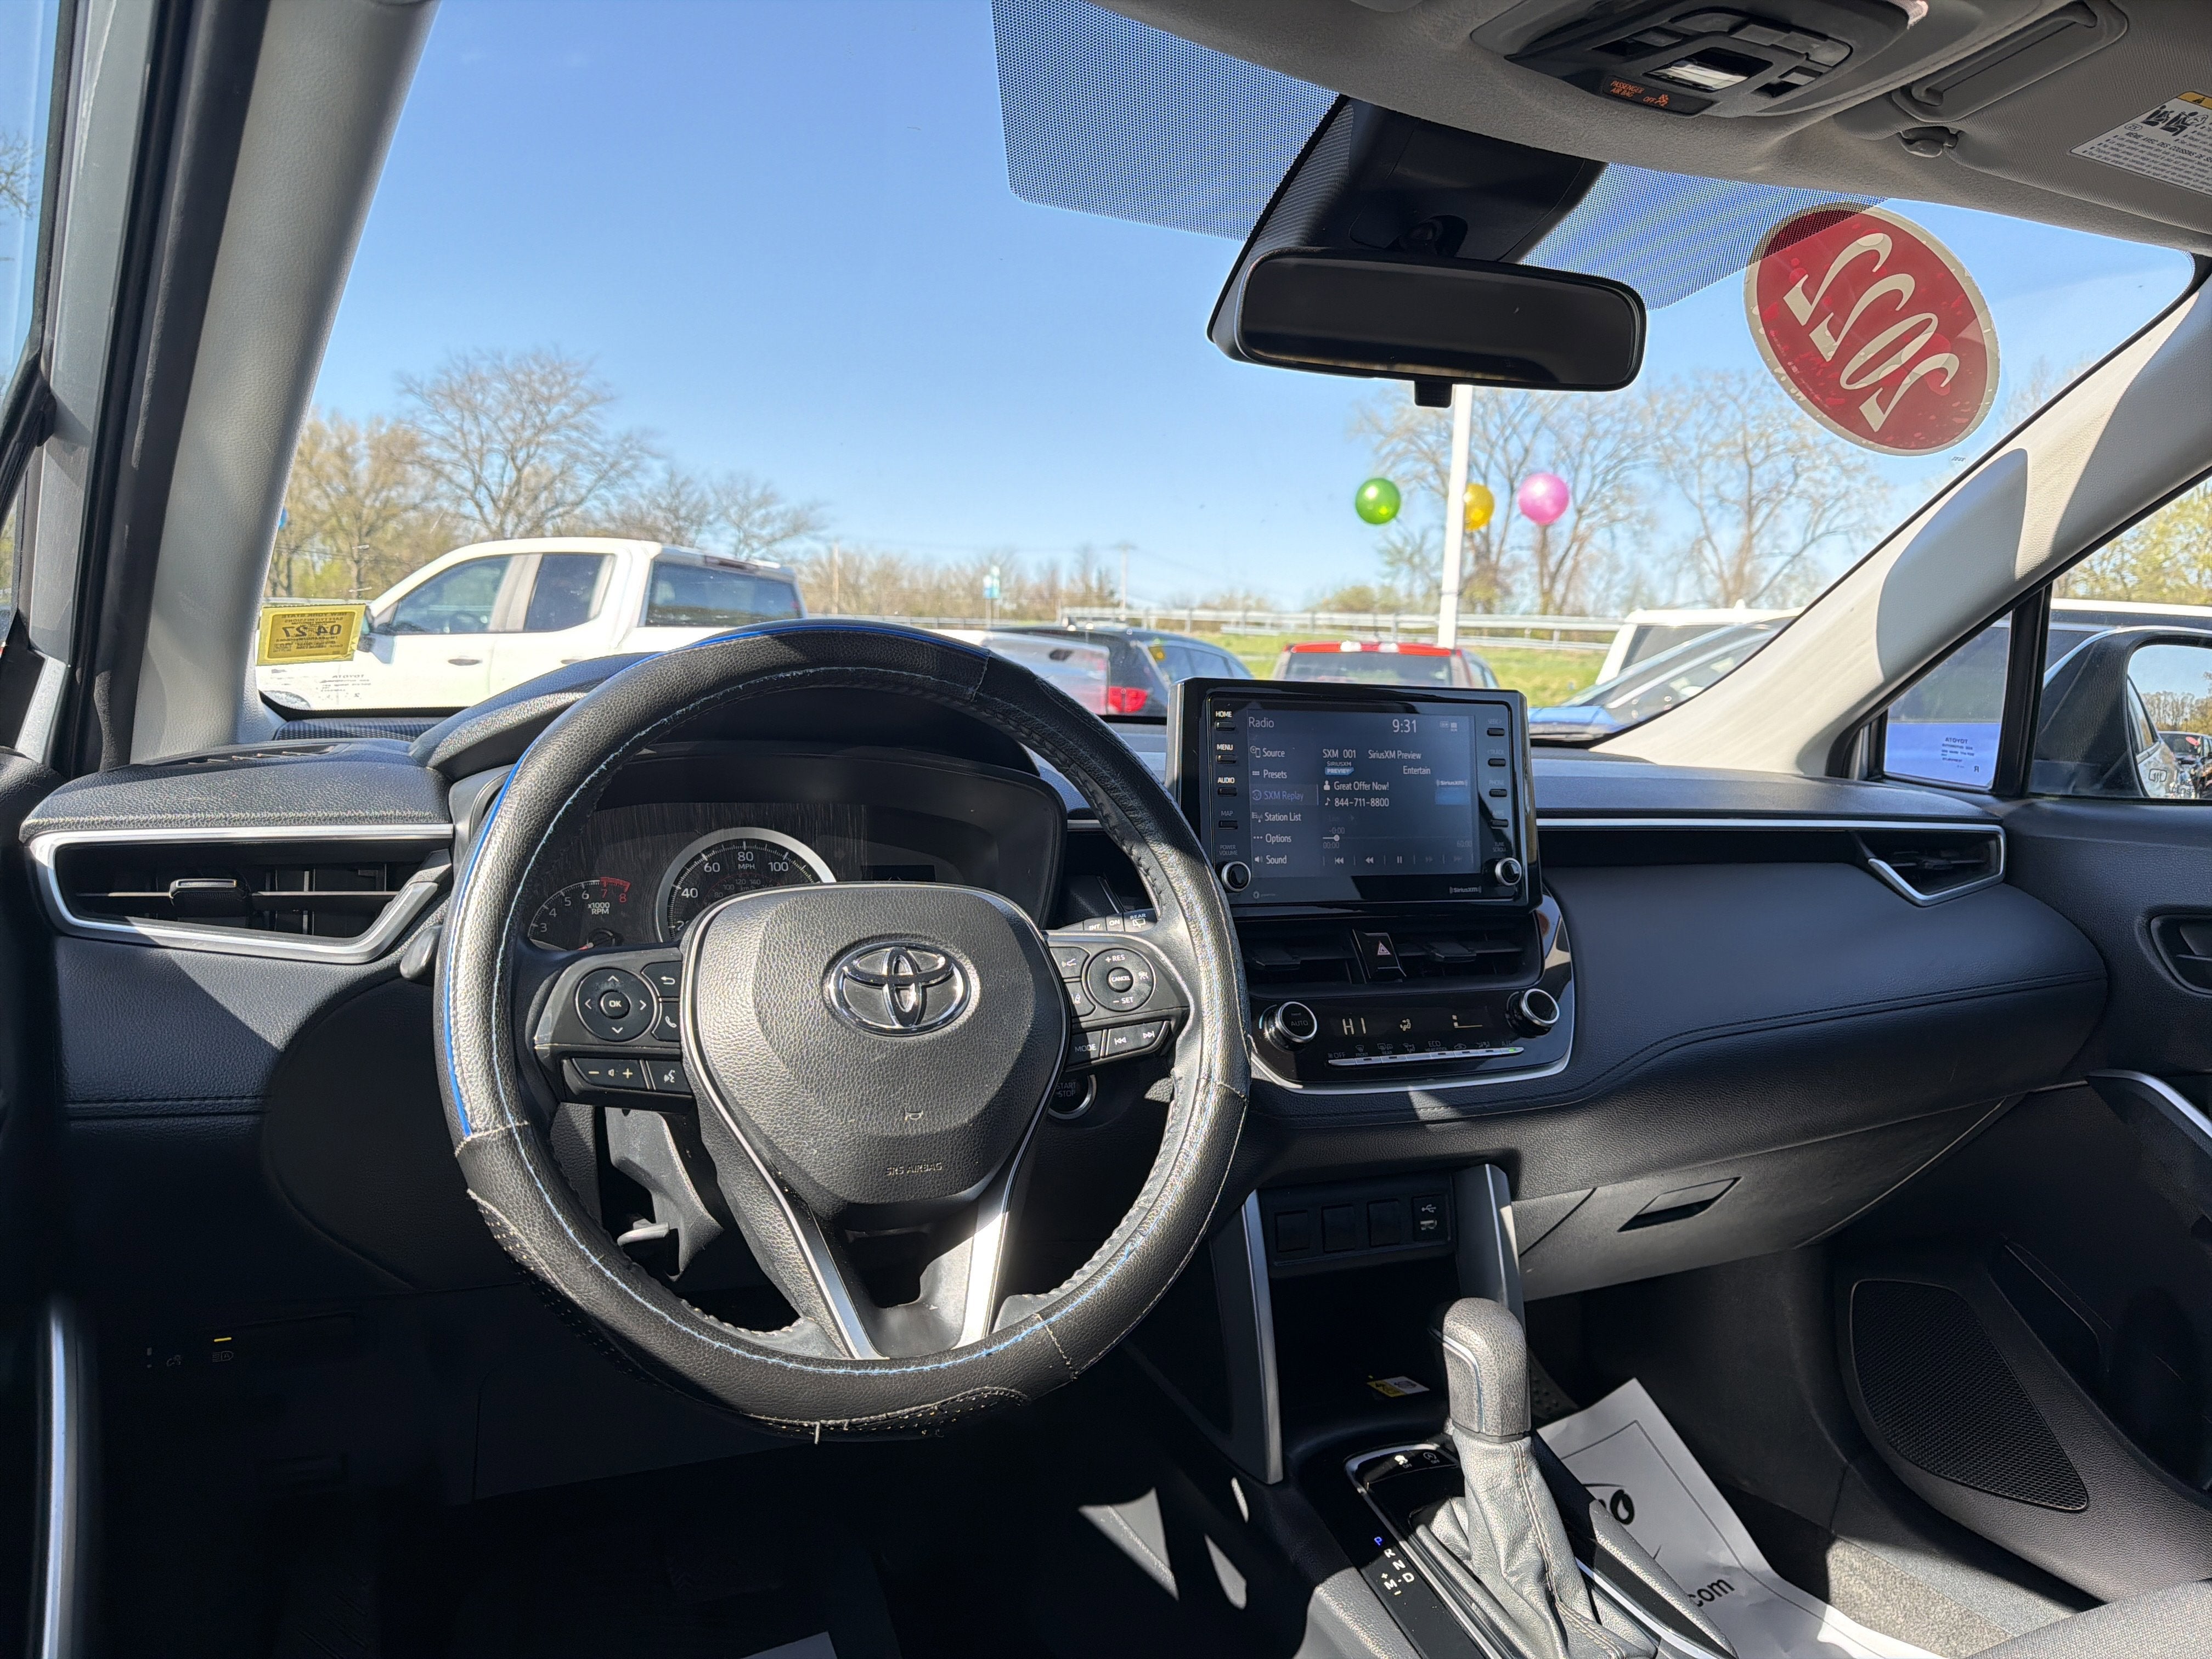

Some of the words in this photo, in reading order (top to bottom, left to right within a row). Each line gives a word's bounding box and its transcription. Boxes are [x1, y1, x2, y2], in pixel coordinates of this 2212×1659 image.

[1610, 80, 1645, 94] PASSENGER
[1249, 716, 1274, 728] Radio
[1392, 719, 1417, 733] 9:31
[1262, 748, 1285, 757] Source
[1323, 749, 1339, 758] SXM
[1343, 749, 1356, 758] 001
[1368, 749, 1396, 759] SiriusXM
[1397, 751, 1421, 759] Preview
[1263, 769, 1288, 778] Presets
[1403, 765, 1431, 775] Entertain
[1334, 781, 1352, 790] Great
[1353, 781, 1370, 790] Offer
[1372, 782, 1389, 791] Now!
[1264, 791, 1280, 800] SXM
[1282, 791, 1304, 802] Replay
[1334, 798, 1389, 807] 844-711-8800
[1265, 812, 1288, 821] Station
[1289, 812, 1301, 821] List
[1265, 833, 1291, 845] Options
[737, 851, 754, 861] 80
[1266, 855, 1287, 865] Sound
[704, 862, 720, 873] 60
[768, 861, 789, 872] 100
[582, 890, 590, 900] 6
[601, 889, 608, 899] 7
[619, 893, 627, 903] 8
[681, 888, 698, 899] 40
[565, 896, 572, 906] 5
[549, 908, 557, 917] 4
[540, 923, 548, 933] 3
[1075, 1044, 1097, 1052] MODE
[885, 1166, 904, 1176] SRS
[906, 1161, 943, 1174] AIRBAG
[1374, 1537, 1383, 1546] P
[1384, 1548, 1396, 1558] R
[1392, 1560, 1406, 1570] N
[1402, 1572, 1415, 1583] D
[1384, 1579, 1397, 1590] M
